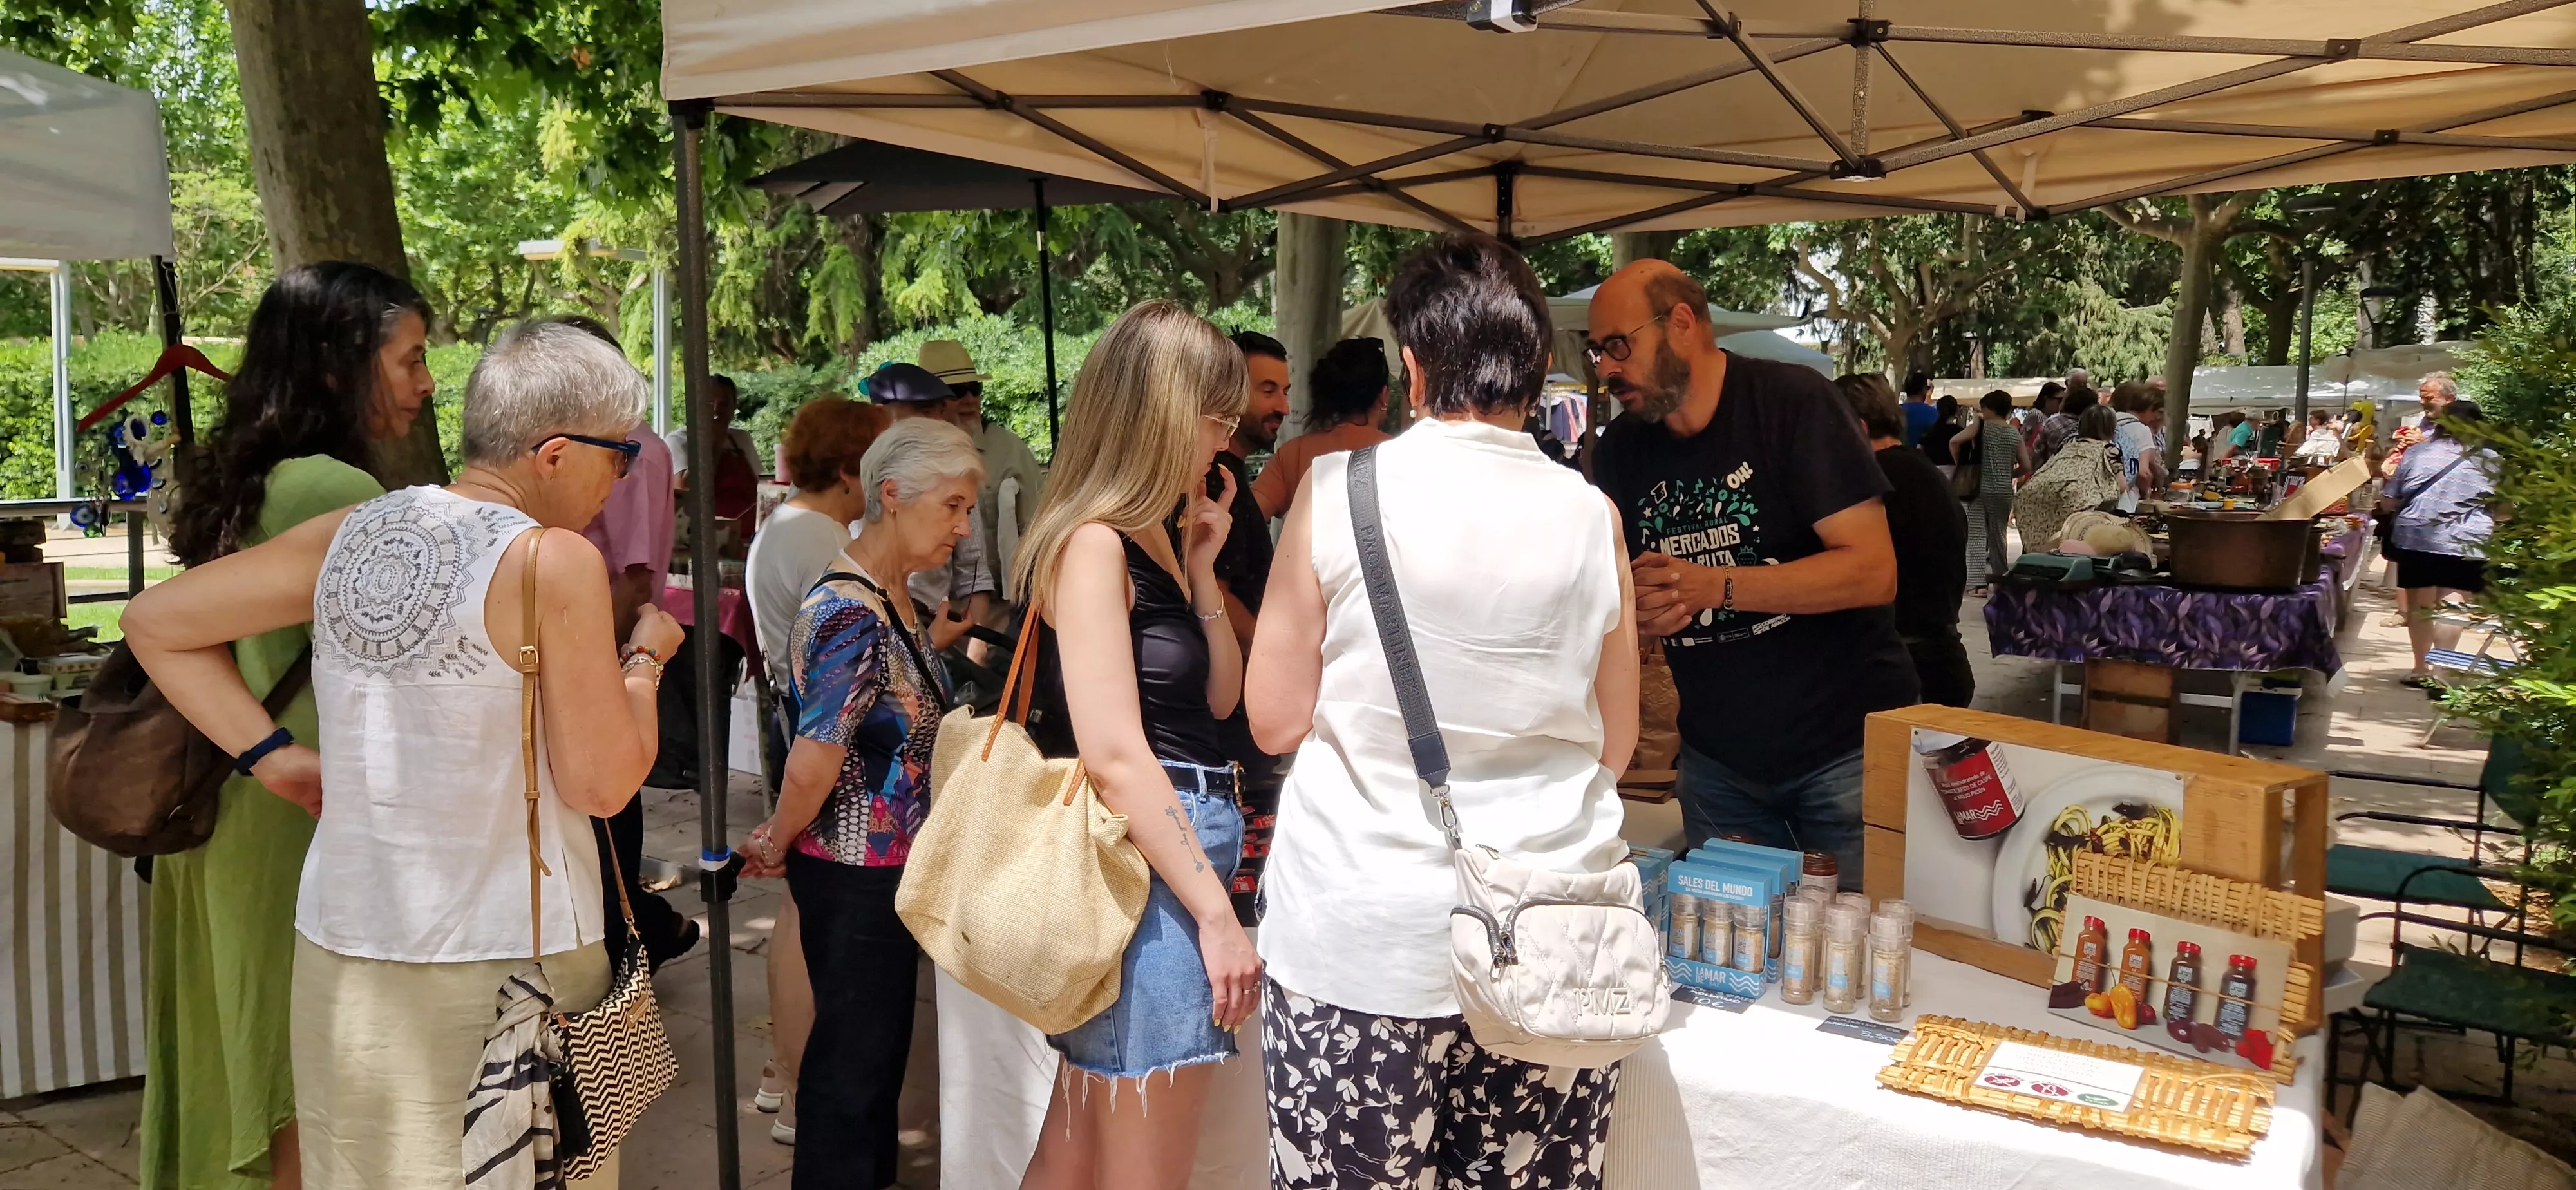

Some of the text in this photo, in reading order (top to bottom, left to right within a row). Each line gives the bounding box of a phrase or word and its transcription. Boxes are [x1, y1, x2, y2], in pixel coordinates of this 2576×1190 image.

[1727, 461, 1754, 489] OH!
[1666, 516, 1729, 535] FESTIVAL RURAL
[1660, 523, 1741, 557] MERCADOS
[1697, 549, 1737, 567] RUTA
[1678, 875, 1703, 889] SALES
[1705, 879, 1721, 892] DEL
[1723, 882, 1753, 897] MUNDO
[1705, 968, 1727, 984] MAR
[1573, 987, 1631, 1015] PMZ
[1692, 996, 1725, 1008] 10€
